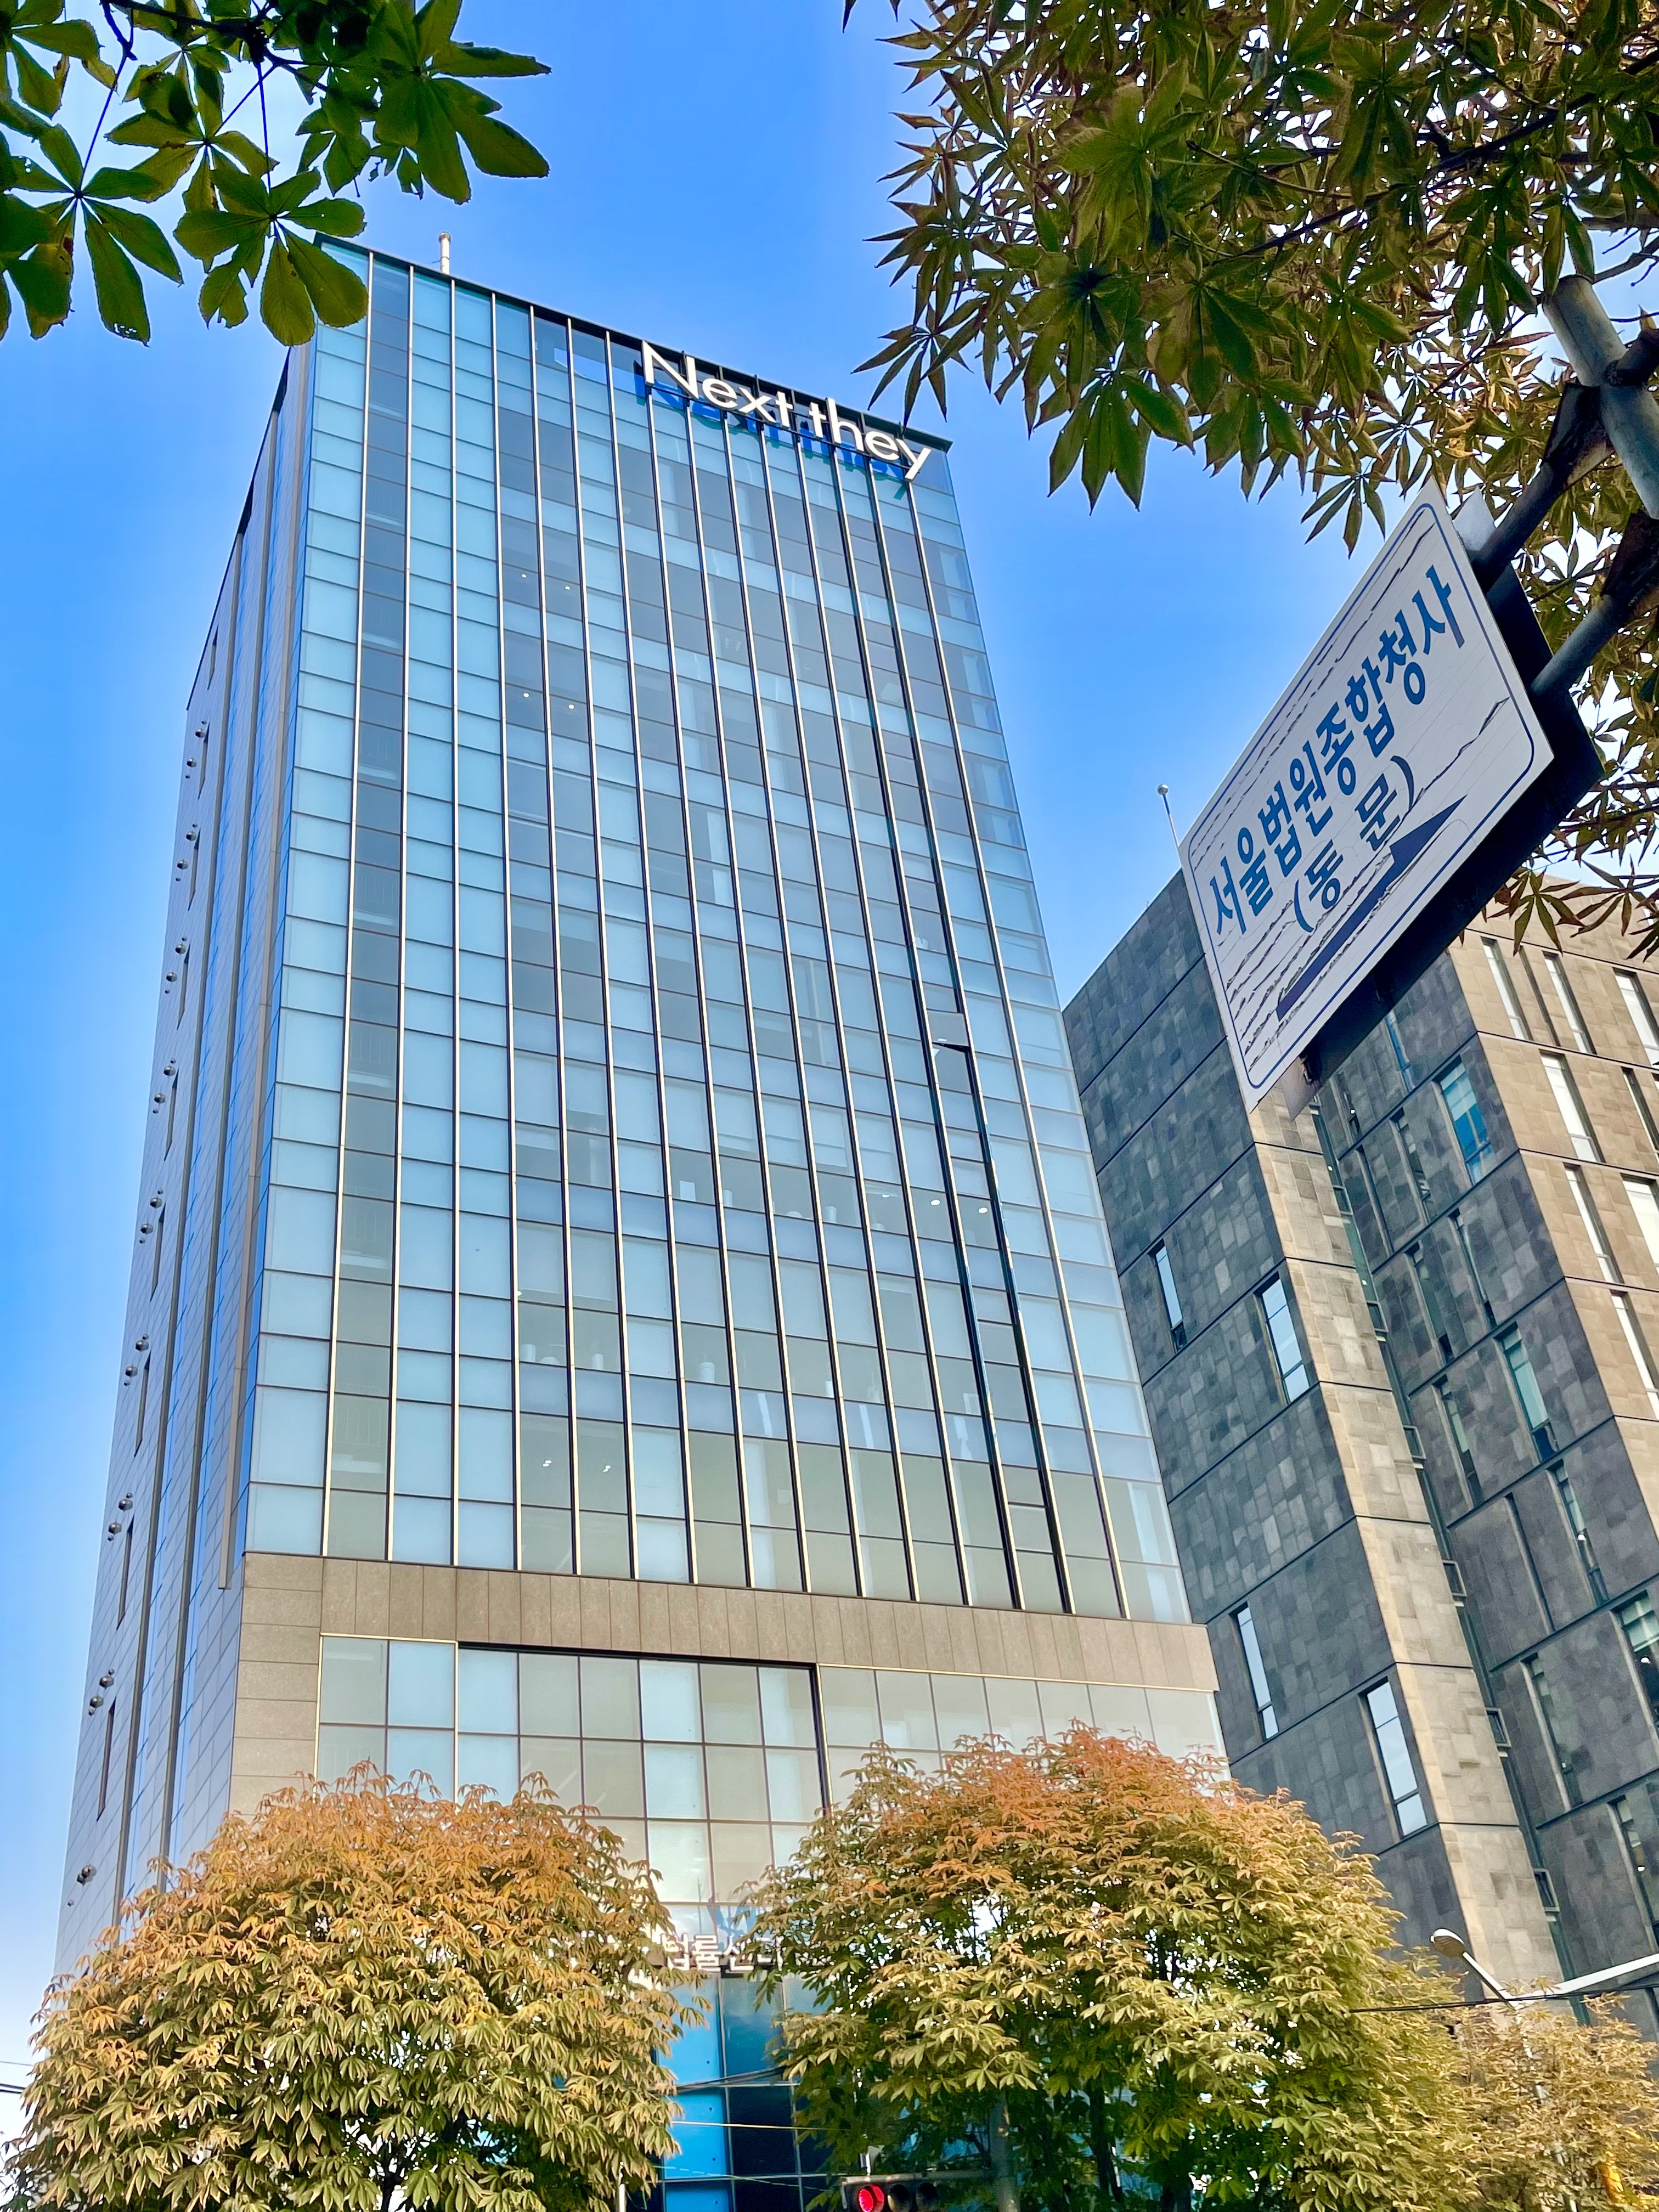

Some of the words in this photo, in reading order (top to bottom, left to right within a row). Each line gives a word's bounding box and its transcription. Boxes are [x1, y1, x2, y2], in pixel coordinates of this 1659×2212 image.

[642, 340, 793, 428] Next
[809, 398, 932, 481] they
[1210, 565, 1464, 935] 서울법원종합청사
